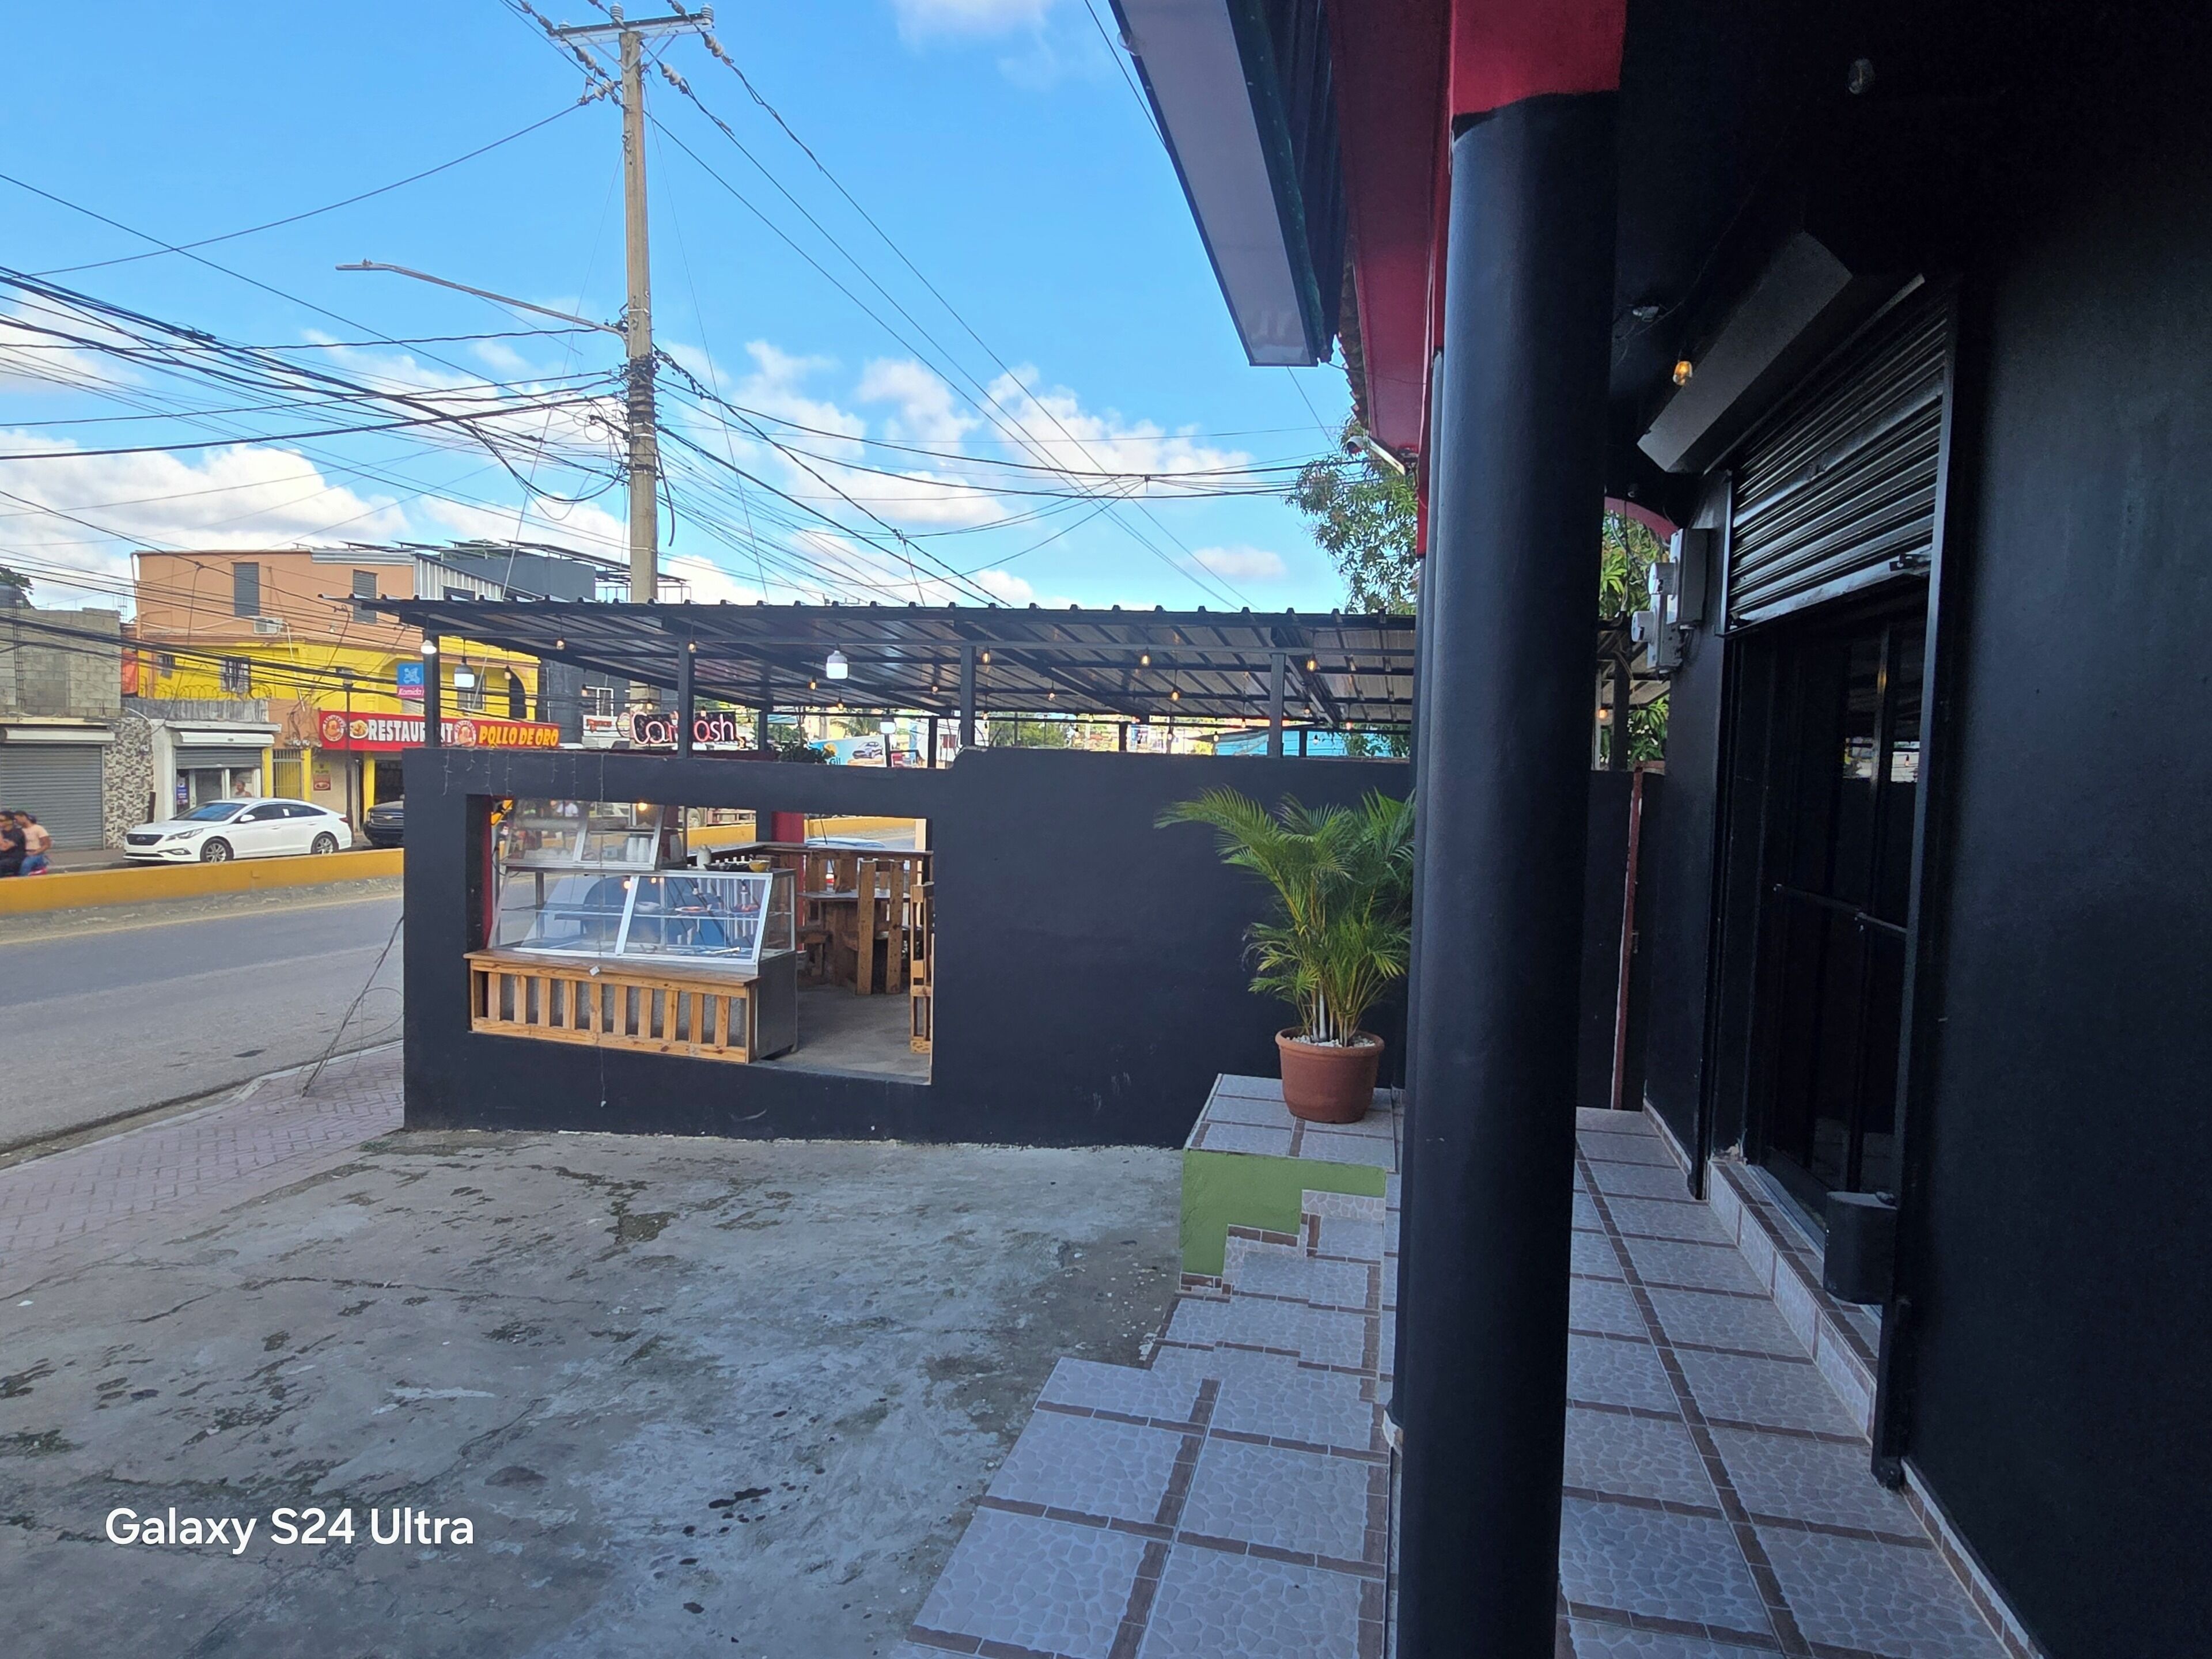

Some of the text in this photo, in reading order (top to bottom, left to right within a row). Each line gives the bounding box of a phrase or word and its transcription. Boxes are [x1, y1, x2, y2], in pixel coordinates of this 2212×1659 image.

[368, 719, 453, 743] RESTAURNT
[479, 725, 518, 745] POLLO
[518, 727, 535, 743] DE
[535, 728, 559, 747] ORO
[693, 714, 734, 743] ash
